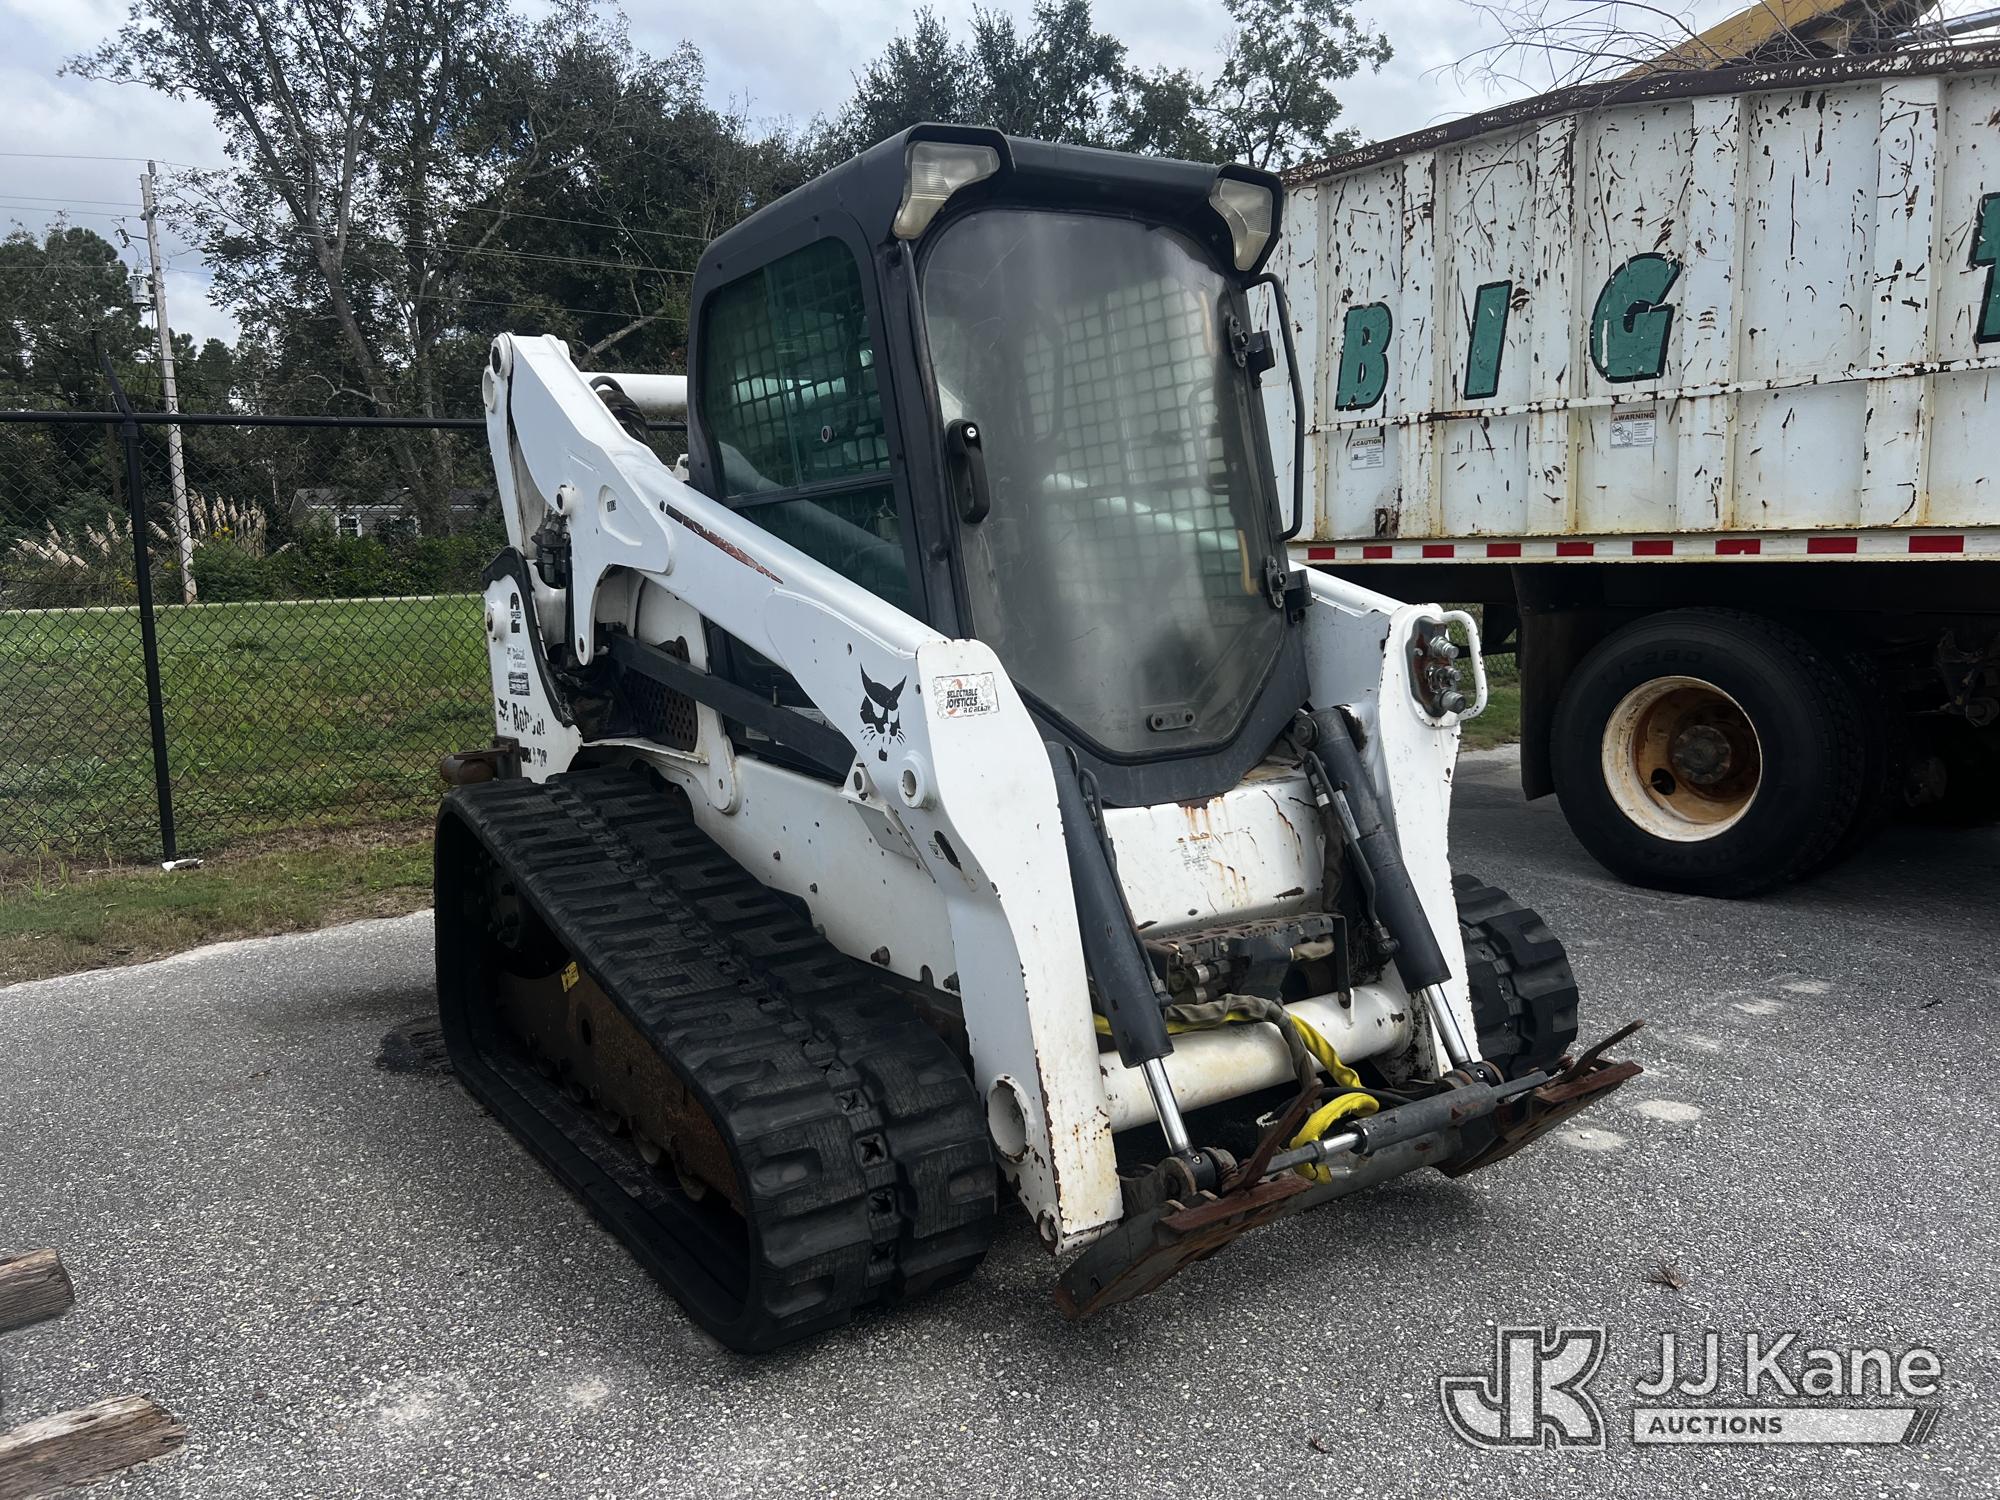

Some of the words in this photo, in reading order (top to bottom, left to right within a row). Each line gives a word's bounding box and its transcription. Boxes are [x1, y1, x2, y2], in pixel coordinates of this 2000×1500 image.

[1335, 251, 1683, 412] BIG
[1618, 412, 1655, 420] WARNING
[1356, 439, 1382, 447] CAUTION
[947, 688, 978, 698] SELECTABLE
[946, 697, 978, 709] JOYSTICKS
